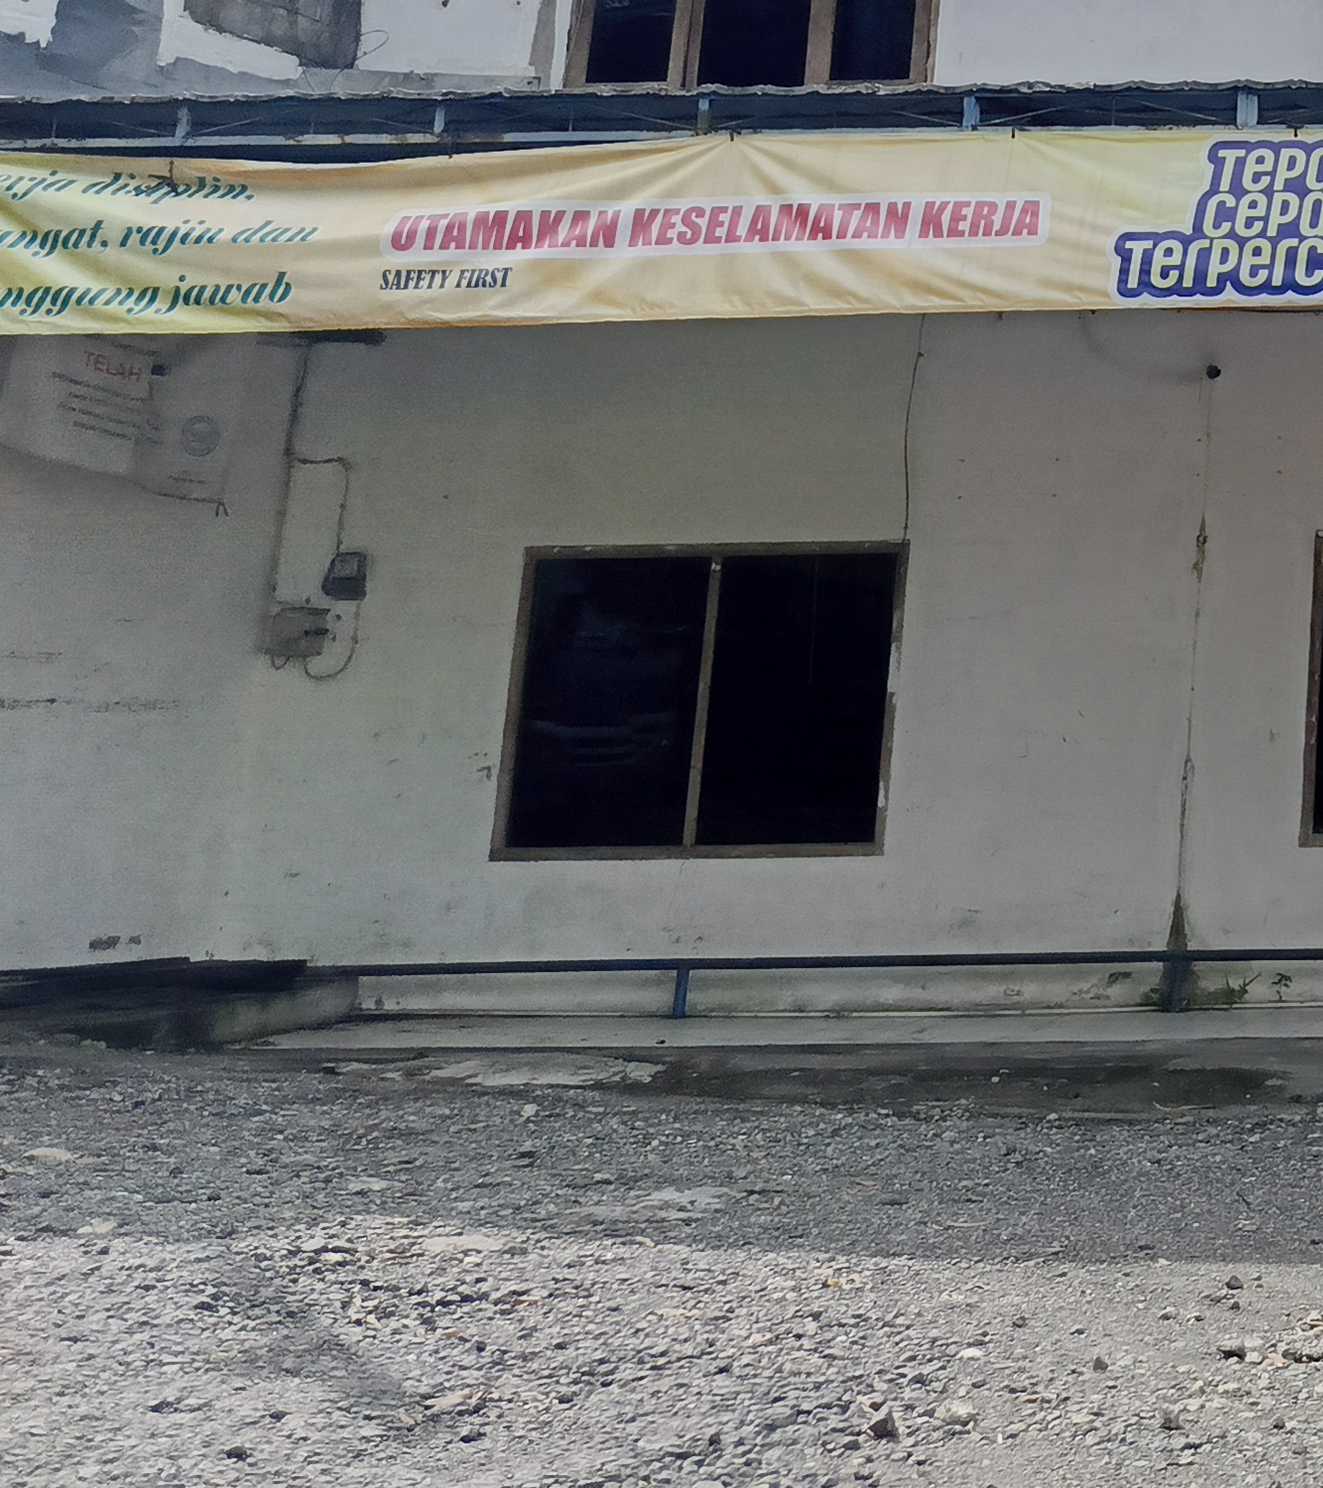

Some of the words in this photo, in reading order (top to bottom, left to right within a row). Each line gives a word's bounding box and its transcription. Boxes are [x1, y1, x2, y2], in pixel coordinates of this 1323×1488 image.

[119, 220, 225, 255] rajin
[231, 220, 319, 245] dan
[390, 208, 620, 252] UTAMAKAN
[628, 201, 910, 248] KESELAMATAN
[920, 199, 1042, 240] KERJA
[154, 271, 293, 316] jawab
[379, 269, 453, 290] SAFETY
[455, 267, 513, 288] FIRST
